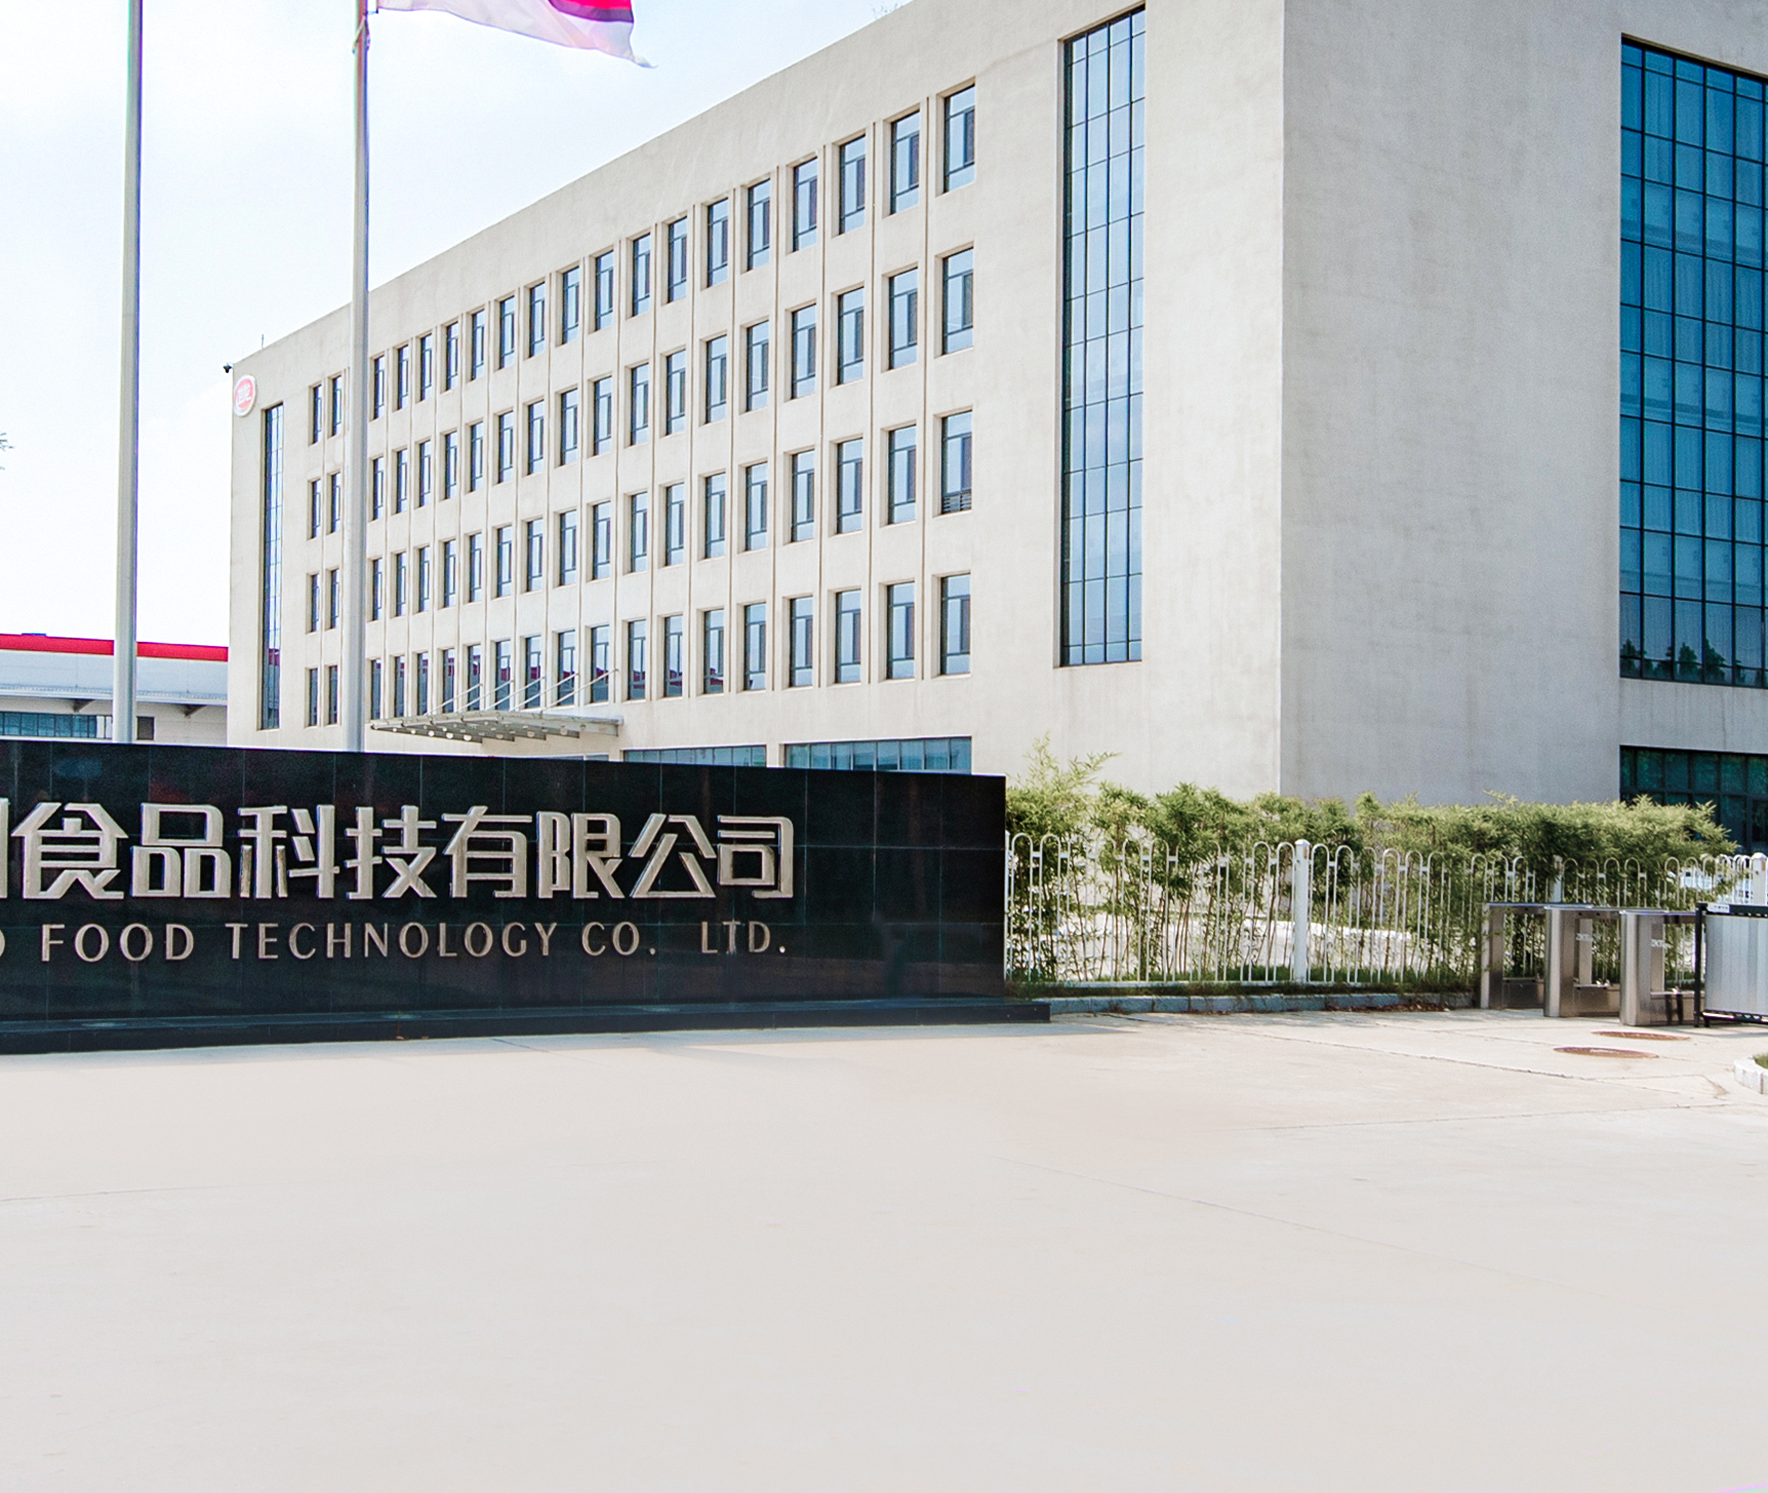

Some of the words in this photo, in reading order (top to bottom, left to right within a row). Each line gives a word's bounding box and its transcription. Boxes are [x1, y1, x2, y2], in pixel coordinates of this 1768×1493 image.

[40, 921, 195, 963] FOOD
[224, 920, 557, 960] TECHNOLOGY
[581, 920, 657, 958] CO.
[700, 920, 786, 955] LTD.
